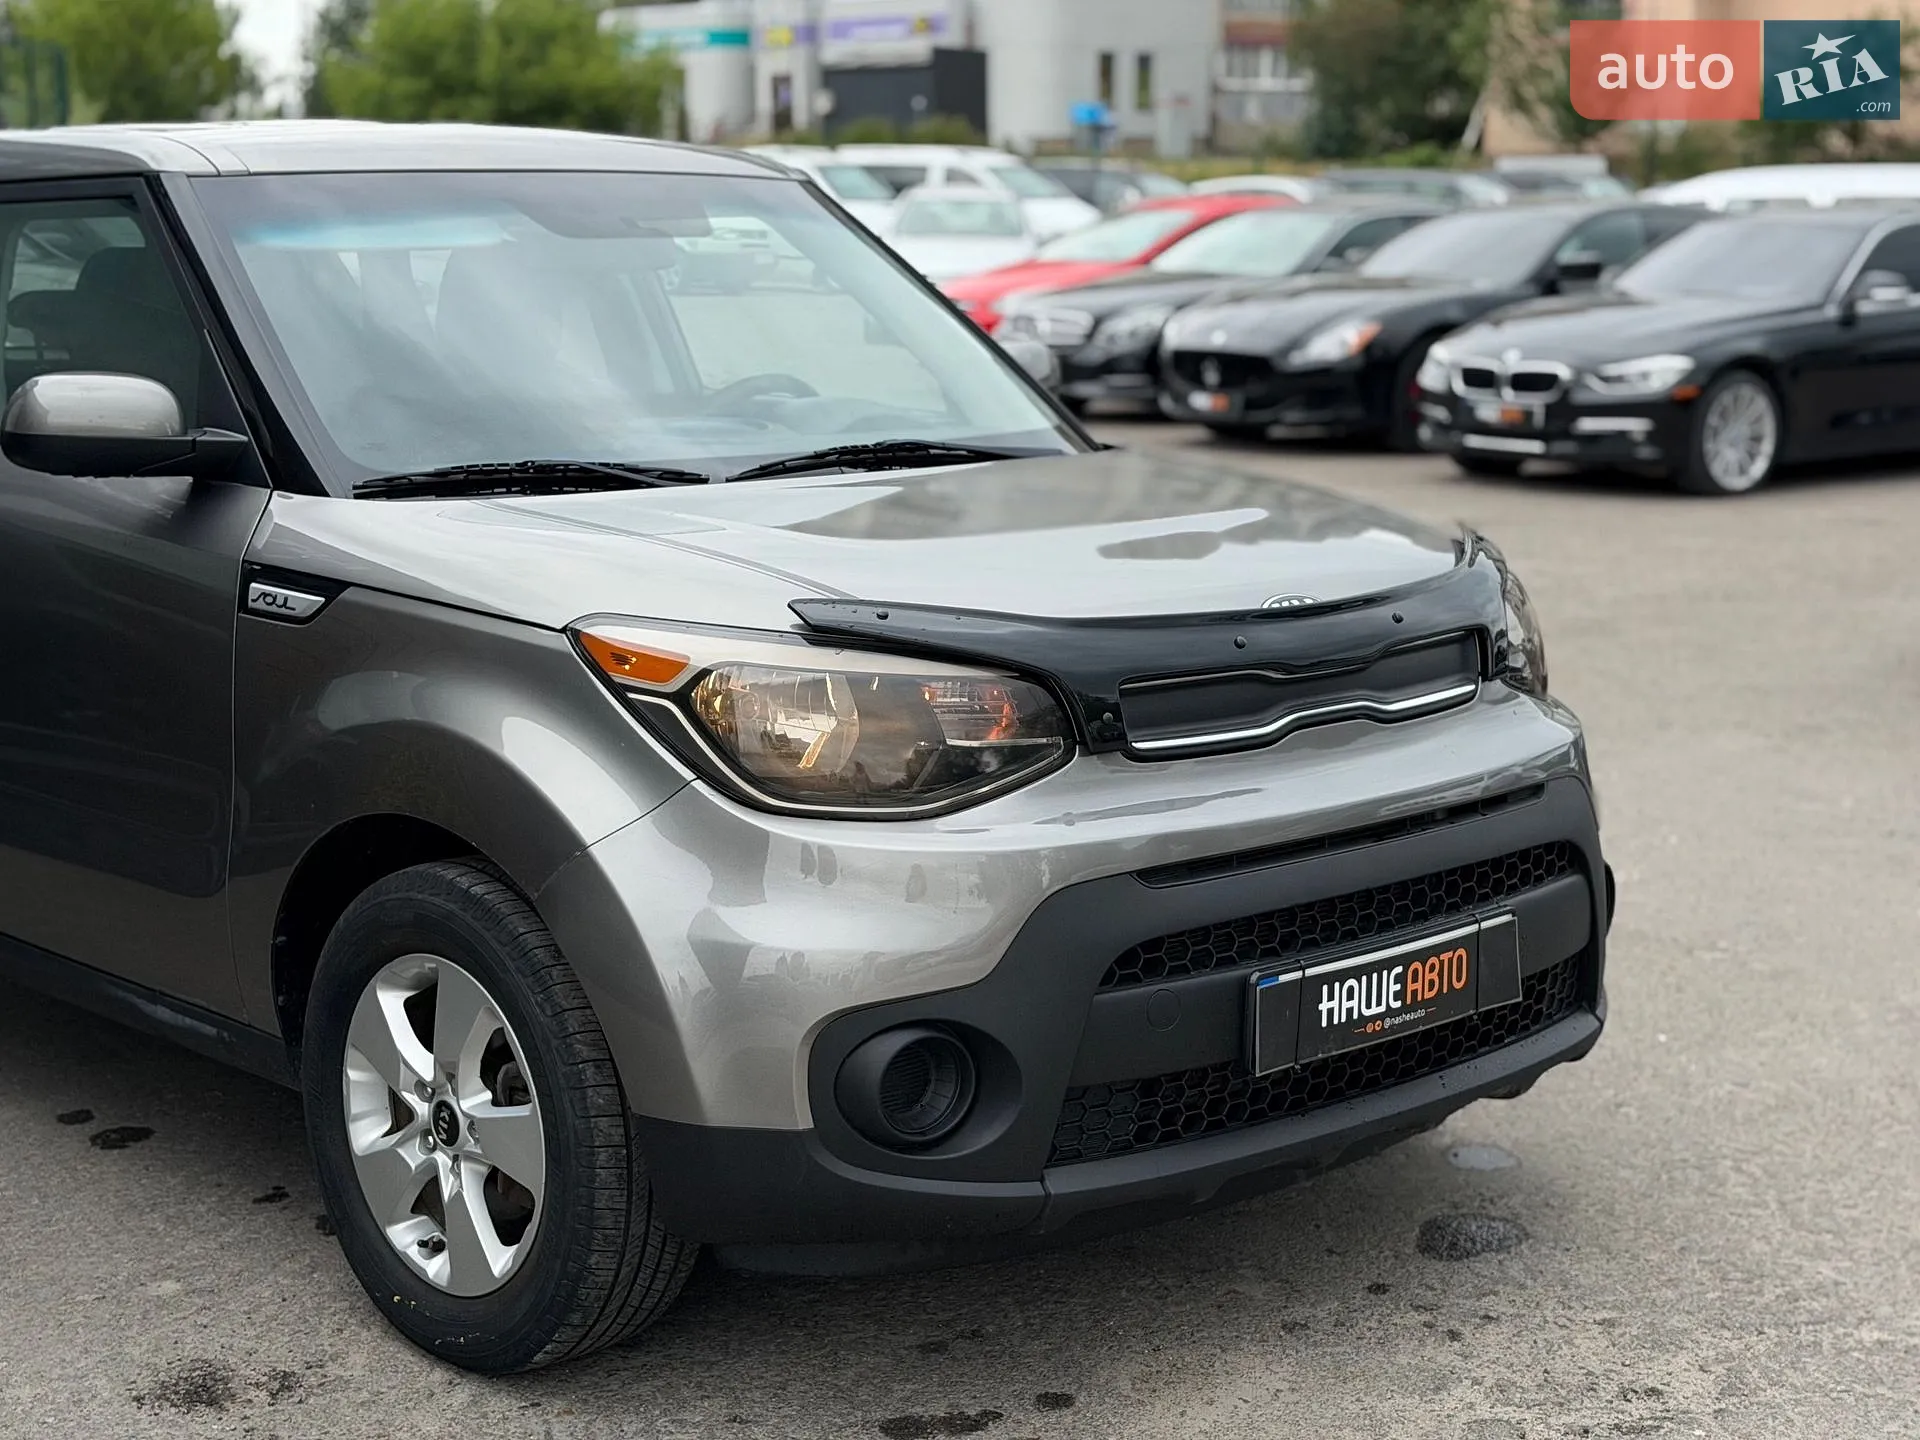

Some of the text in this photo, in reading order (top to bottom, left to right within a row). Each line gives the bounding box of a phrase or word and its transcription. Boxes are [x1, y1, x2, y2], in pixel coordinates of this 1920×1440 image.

[1318, 947, 1467, 1027] НАШЕ АВТО
[1383, 1008, 1426, 1029] @nasheauto
